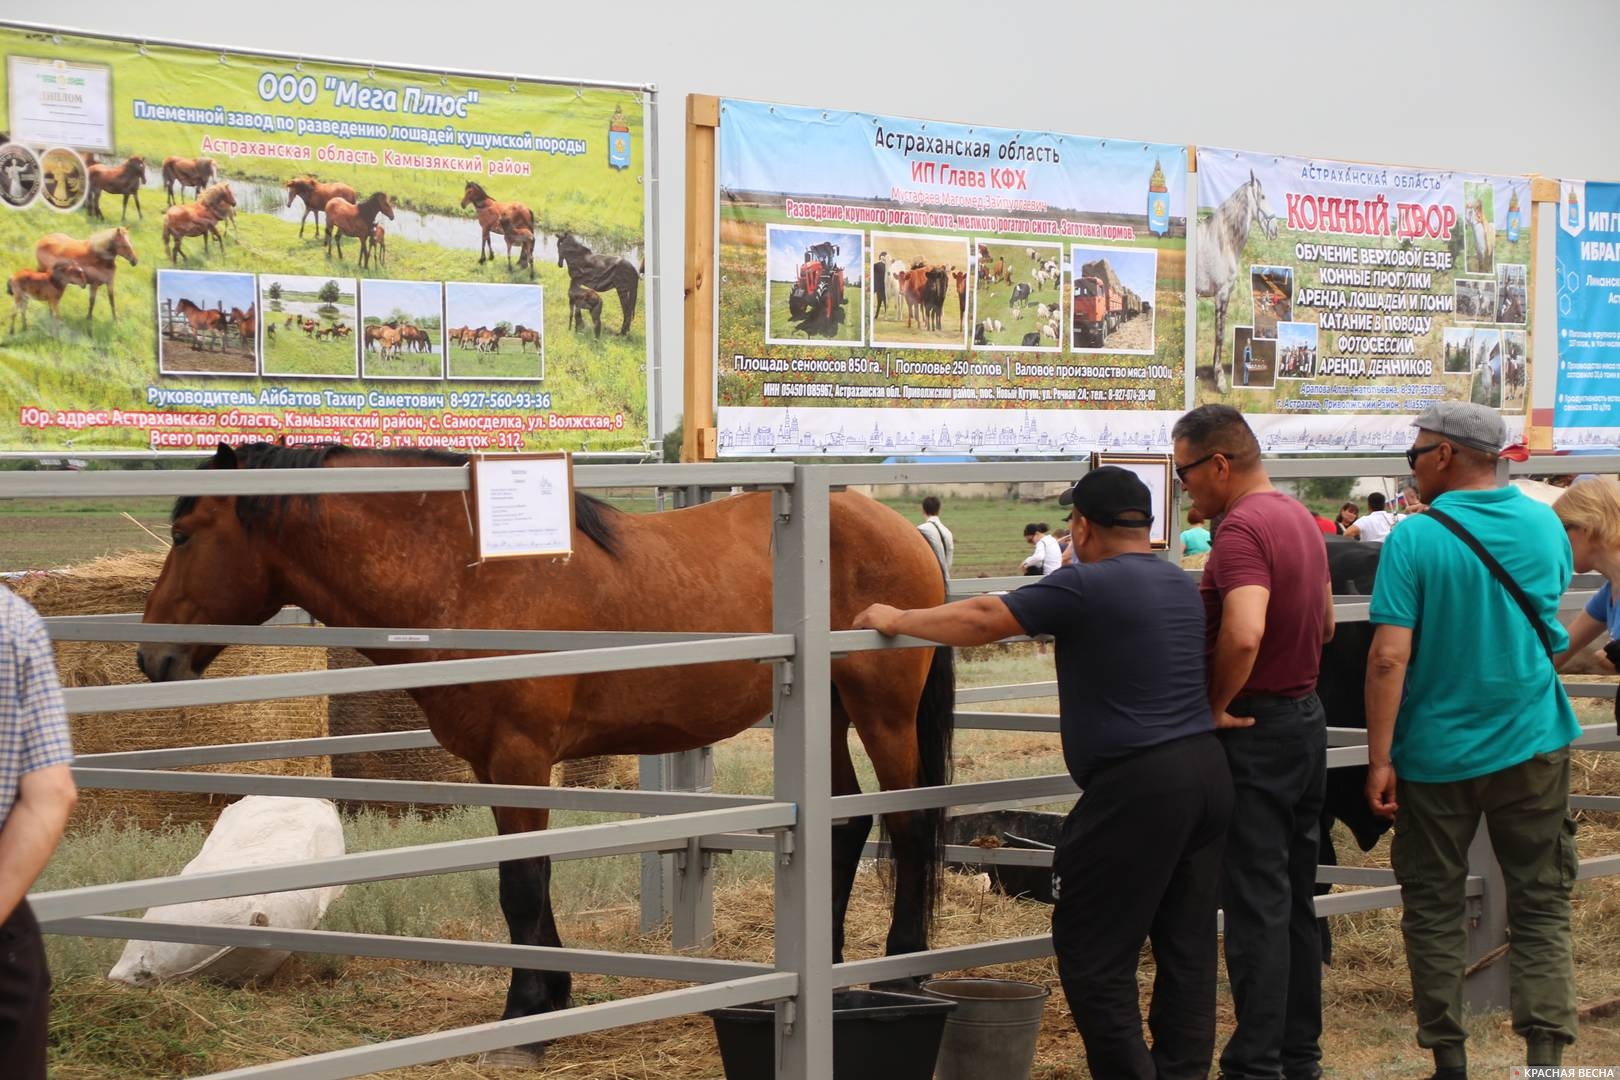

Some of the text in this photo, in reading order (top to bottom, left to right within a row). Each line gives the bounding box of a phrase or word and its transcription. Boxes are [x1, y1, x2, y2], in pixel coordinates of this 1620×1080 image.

[258, 73, 479, 117] ООО "Мега Плюс"
[133, 100, 586, 154] Племенной завод по разведению лошадей кушумской породы
[202, 136, 531, 176] Астраханская область Камызякский район
[875, 127, 1060, 163] Астраханская область
[911, 160, 1027, 190] ИП Глава КФХ
[1301, 166, 1441, 191] АСТРАХАНСКАЯ ОБЛАСТЬ
[891, 187, 940, 207] Мустафаев
[943, 192, 984, 209] Магомед
[786, 199, 1136, 240] Разведение крупного рогатого скота, мелкого рогатого скота. Заготовка кормов.
[1285, 192, 1458, 241] КОННЫЙ ДВОР
[1295, 242, 1452, 269] ОБУЧЕНИЕ ВЕРХОВОЙ ЕЗДЕ
[1319, 268, 1431, 289] КОННЫЕ ПРОГУЛКИ
[1297, 288, 1453, 312] АРЕНДА ЛОШАДЕЙ И ПОНИ
[1319, 313, 1432, 335] КАТАНИЕ В ПОВОДУ
[1338, 336, 1415, 354] ФОТОСЕССИИ
[734, 355, 789, 374] Площадь
[791, 358, 847, 373] сенокосов
[848, 358, 867, 373] 850
[869, 361, 882, 373] га.
[895, 359, 951, 375] Поголовье
[952, 361, 969, 375] 250
[970, 363, 1002, 376] голов
[1015, 363, 1055, 377] Валовое
[1056, 365, 1127, 380] производство
[1127, 368, 1146, 379] мяса
[1318, 357, 1432, 377] АРЕНДА ДЕННИКОВ
[148, 388, 551, 409] Руководитель Айбатов Тахир Саметович 8-927-560-93-36
[763, 383, 781, 397] ИНН
[834, 385, 885, 400] Астраханская
[902, 384, 951, 400] Приволжский
[21, 408, 623, 431] Юр. адрес: Астраханская область, Камызякский район, с. Самосделка, ул. Волжская, 8
[150, 430, 193, 445] Всего
[197, 433, 274, 445] поголовье
[279, 431, 342, 446] ошадей
[382, 436, 391, 447] в
[393, 435, 414, 447] т.ч.
[418, 435, 489, 448] конематок
[498, 434, 525, 447] 312.
